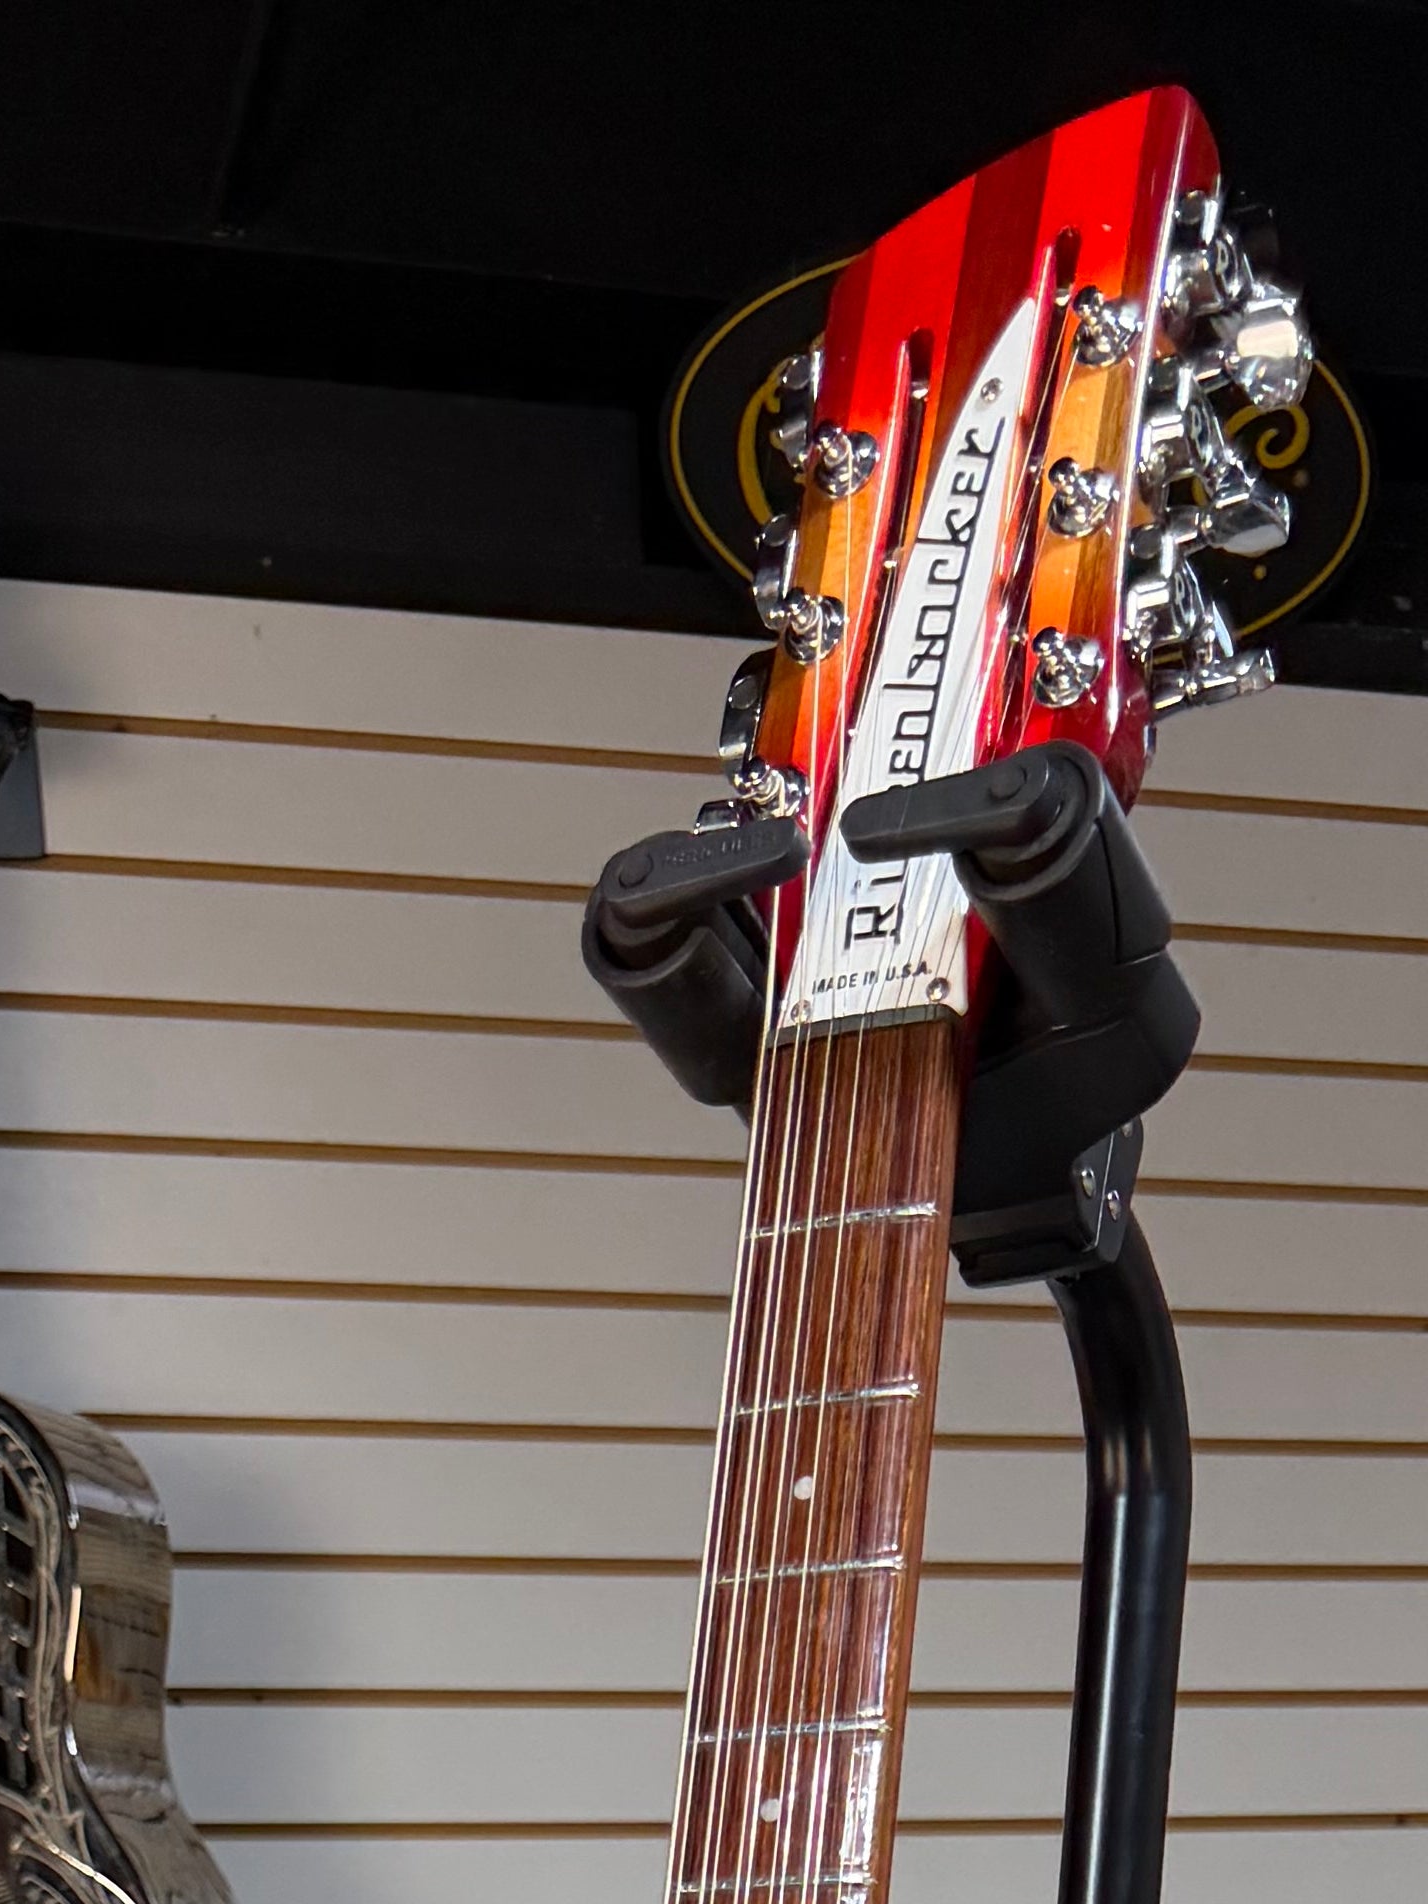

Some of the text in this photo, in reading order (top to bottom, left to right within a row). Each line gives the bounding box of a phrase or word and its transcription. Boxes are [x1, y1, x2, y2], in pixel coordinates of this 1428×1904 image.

[843, 415, 1006, 951] Rienbacker
[811, 960, 933, 995] MADE IN U.S.A.
